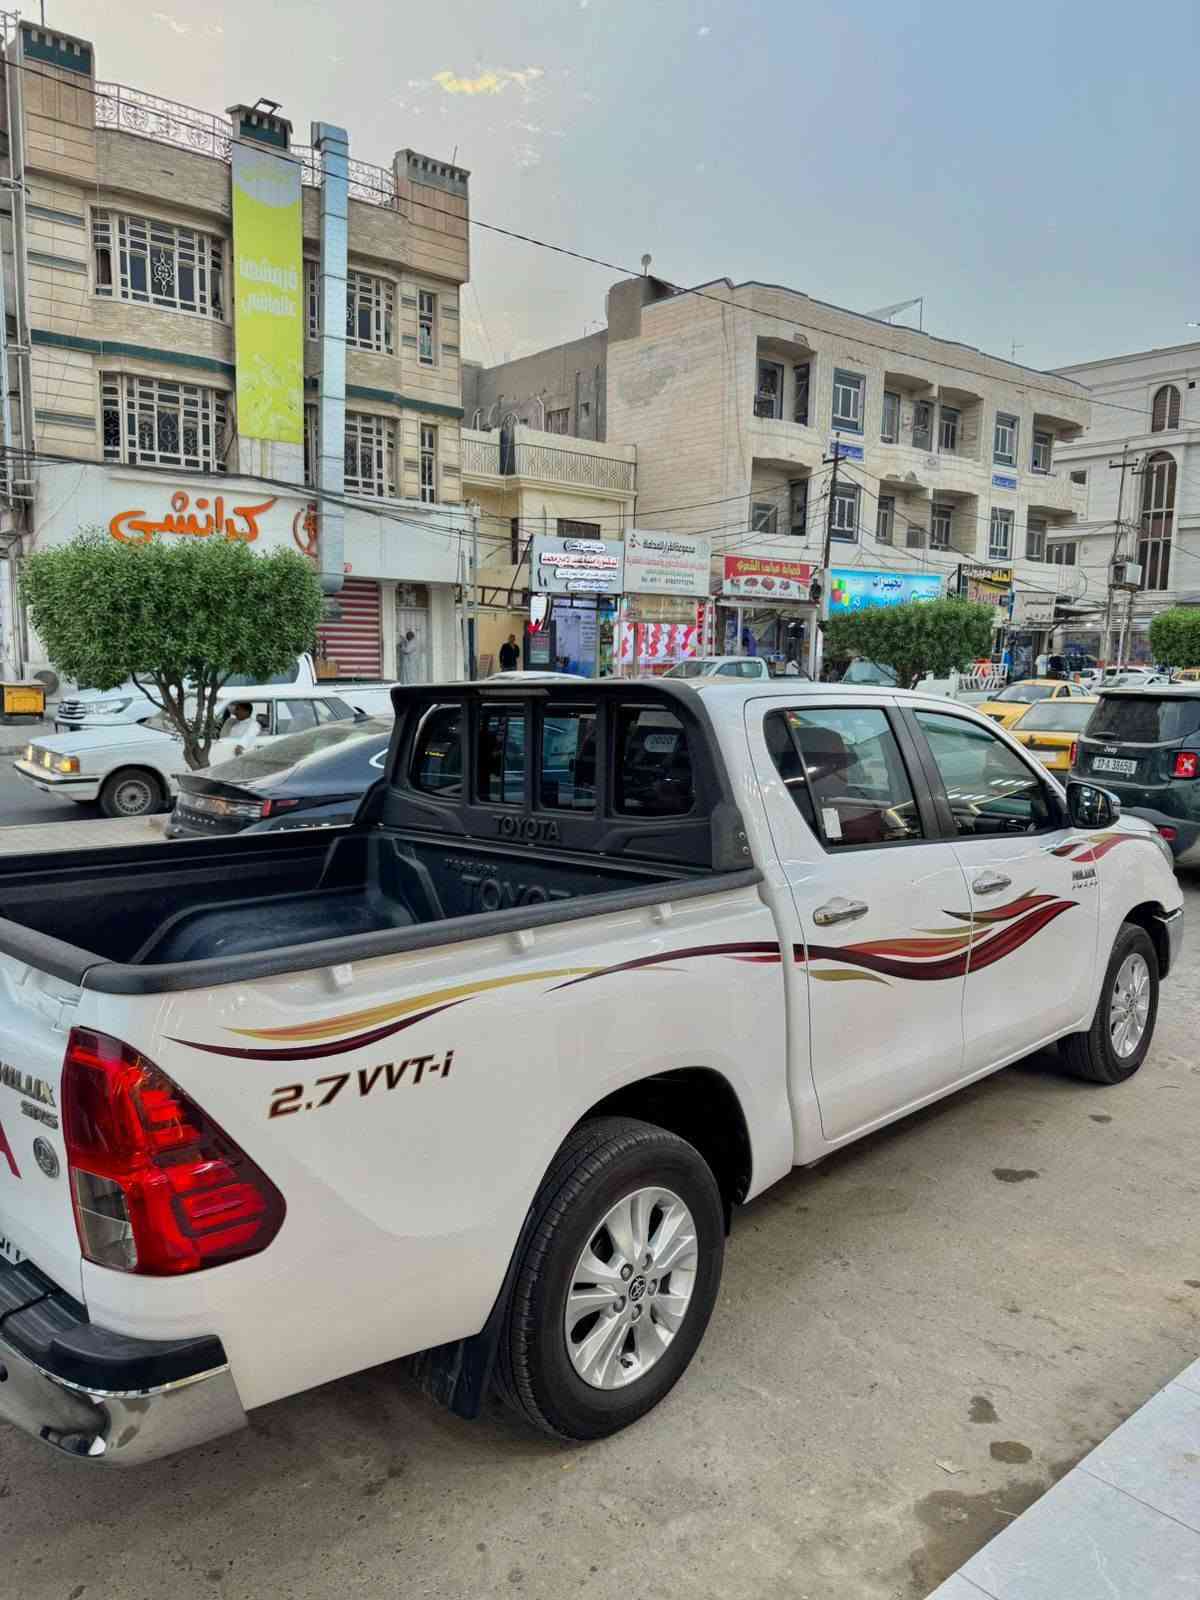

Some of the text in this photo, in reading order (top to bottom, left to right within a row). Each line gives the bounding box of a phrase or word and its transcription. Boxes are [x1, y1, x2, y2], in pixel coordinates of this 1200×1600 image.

[1104, 745, 1118, 754] Jeep
[493, 814, 562, 840] TOYOTA
[268, 1049, 455, 1120] 2.7 VVT-i
